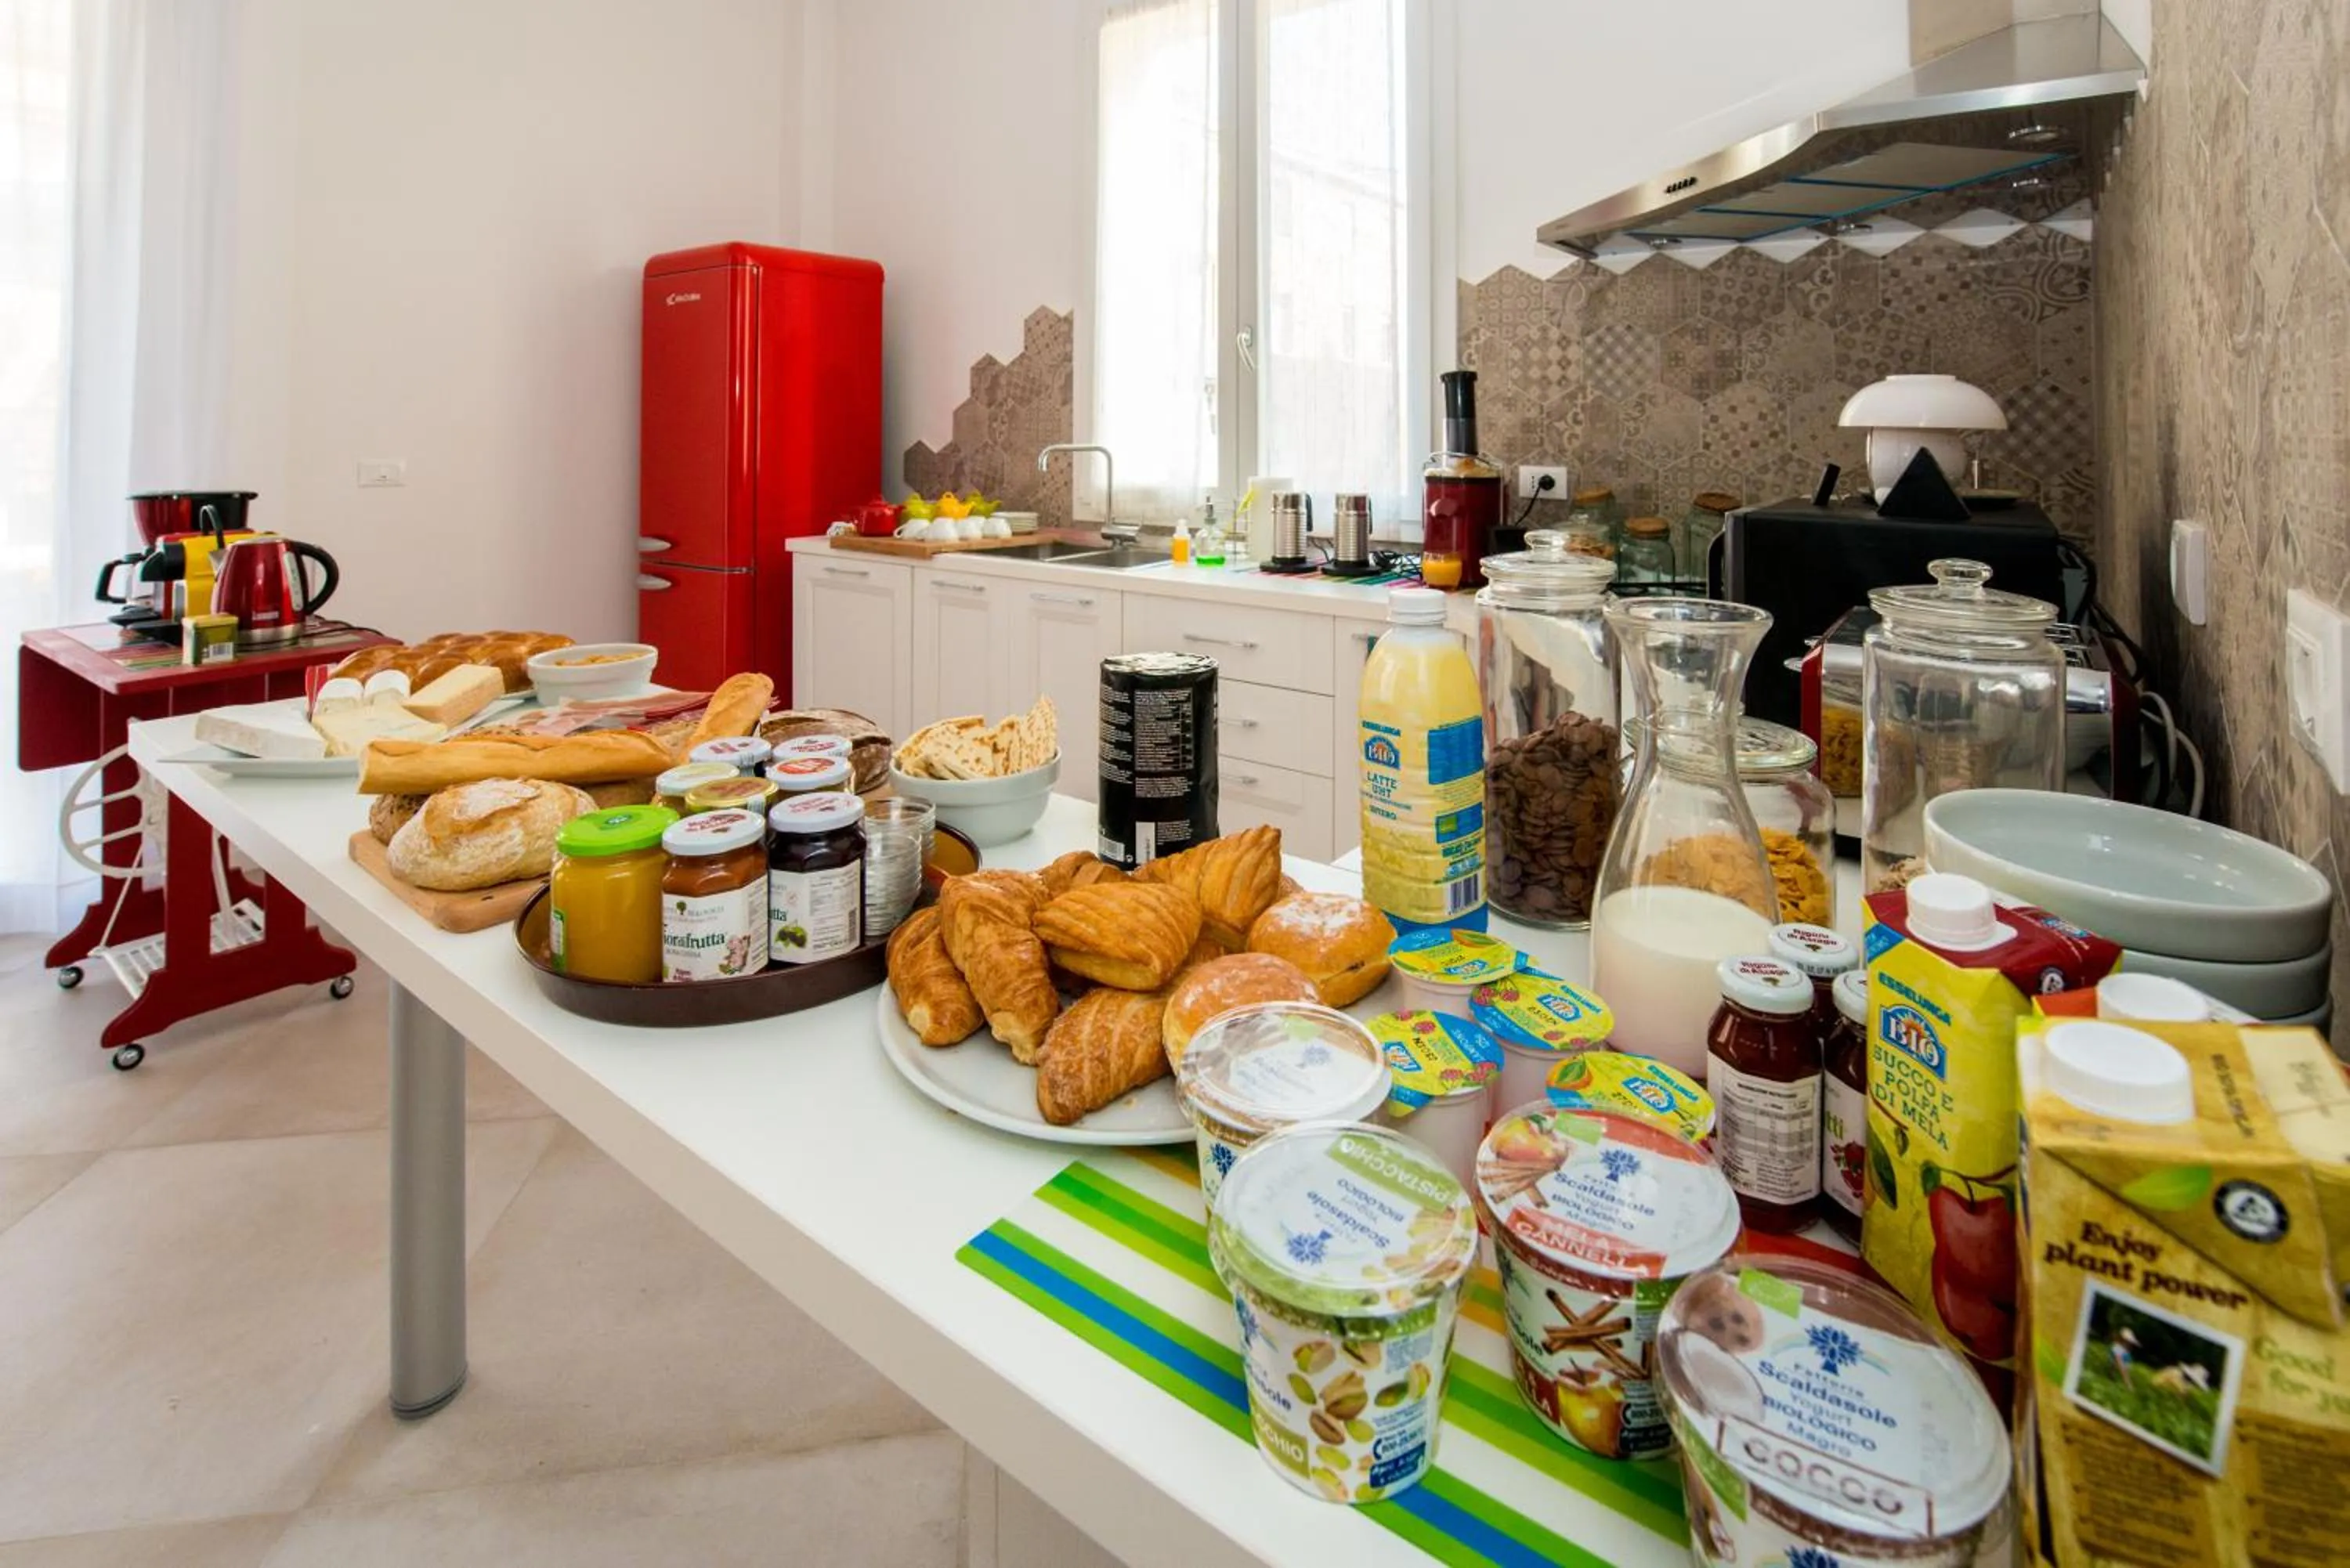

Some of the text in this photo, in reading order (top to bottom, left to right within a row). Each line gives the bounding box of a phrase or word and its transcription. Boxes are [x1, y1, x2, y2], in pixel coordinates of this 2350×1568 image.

[1367, 771, 1397, 789] LATTE
[1889, 1016, 1940, 1067] BIO
[1874, 1044, 1954, 1113] SUCCO E
[1885, 1070, 1940, 1123] POLPA
[1875, 1083, 1948, 1151] DI MELA
[1340, 1137, 1450, 1202] PISTACCHIO
[1554, 1172, 1655, 1216] Scaldasole
[1306, 1190, 1390, 1249] Scaldasole
[2080, 1219, 2163, 1263] Enjoy
[2043, 1241, 2249, 1310] plant power
[2251, 1335, 2335, 1382] Good
[2269, 1366, 2312, 1396] for
[1759, 1360, 1897, 1428] Scaldasole
[1791, 1391, 1852, 1426] Yogurt
[1762, 1394, 1877, 1451] BIOLOGICO
[1787, 1421, 1851, 1458] Magro
[1743, 1438, 1904, 1515] COCCO
